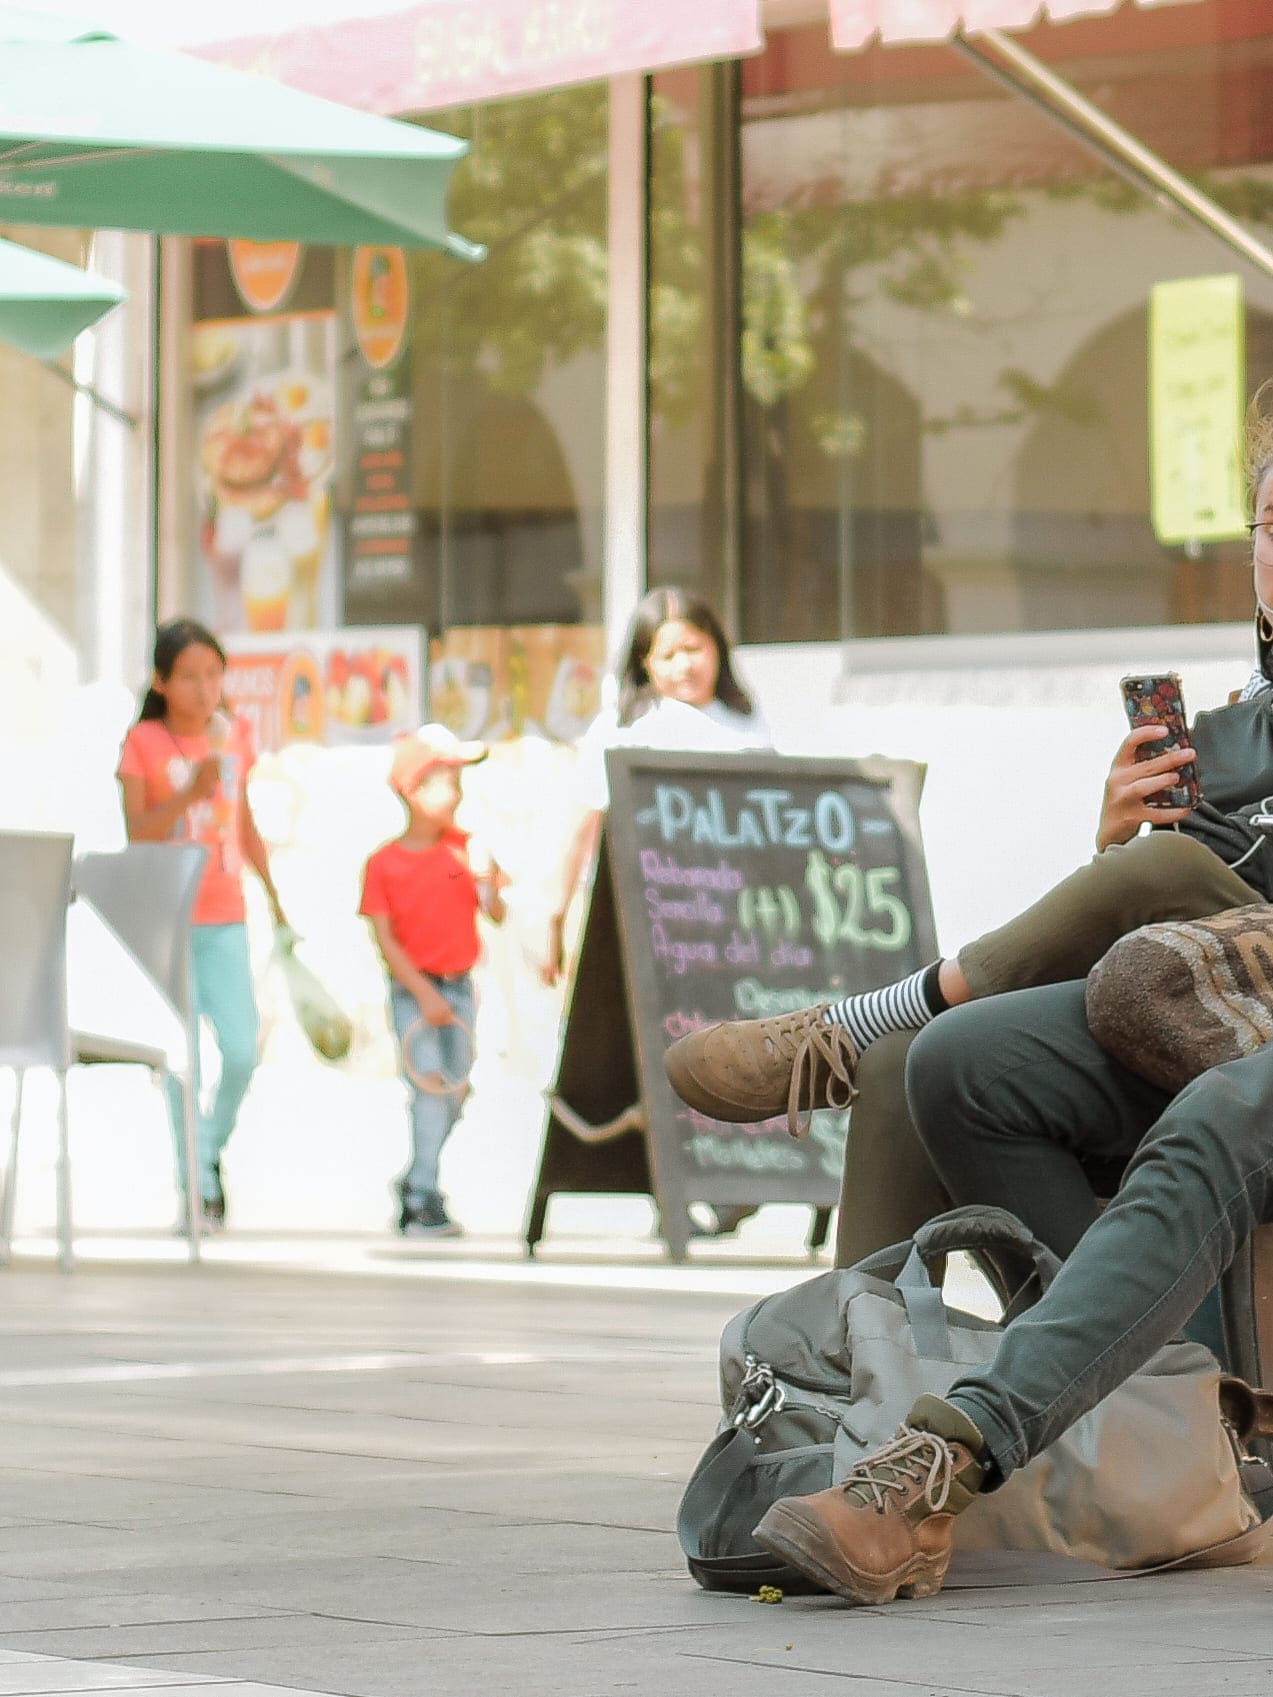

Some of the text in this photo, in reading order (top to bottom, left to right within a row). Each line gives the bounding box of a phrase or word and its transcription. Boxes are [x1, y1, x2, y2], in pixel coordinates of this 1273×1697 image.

[804, 850, 913, 951] $25
[651, 922, 717, 975] Agua
[724, 929, 761, 964] del
